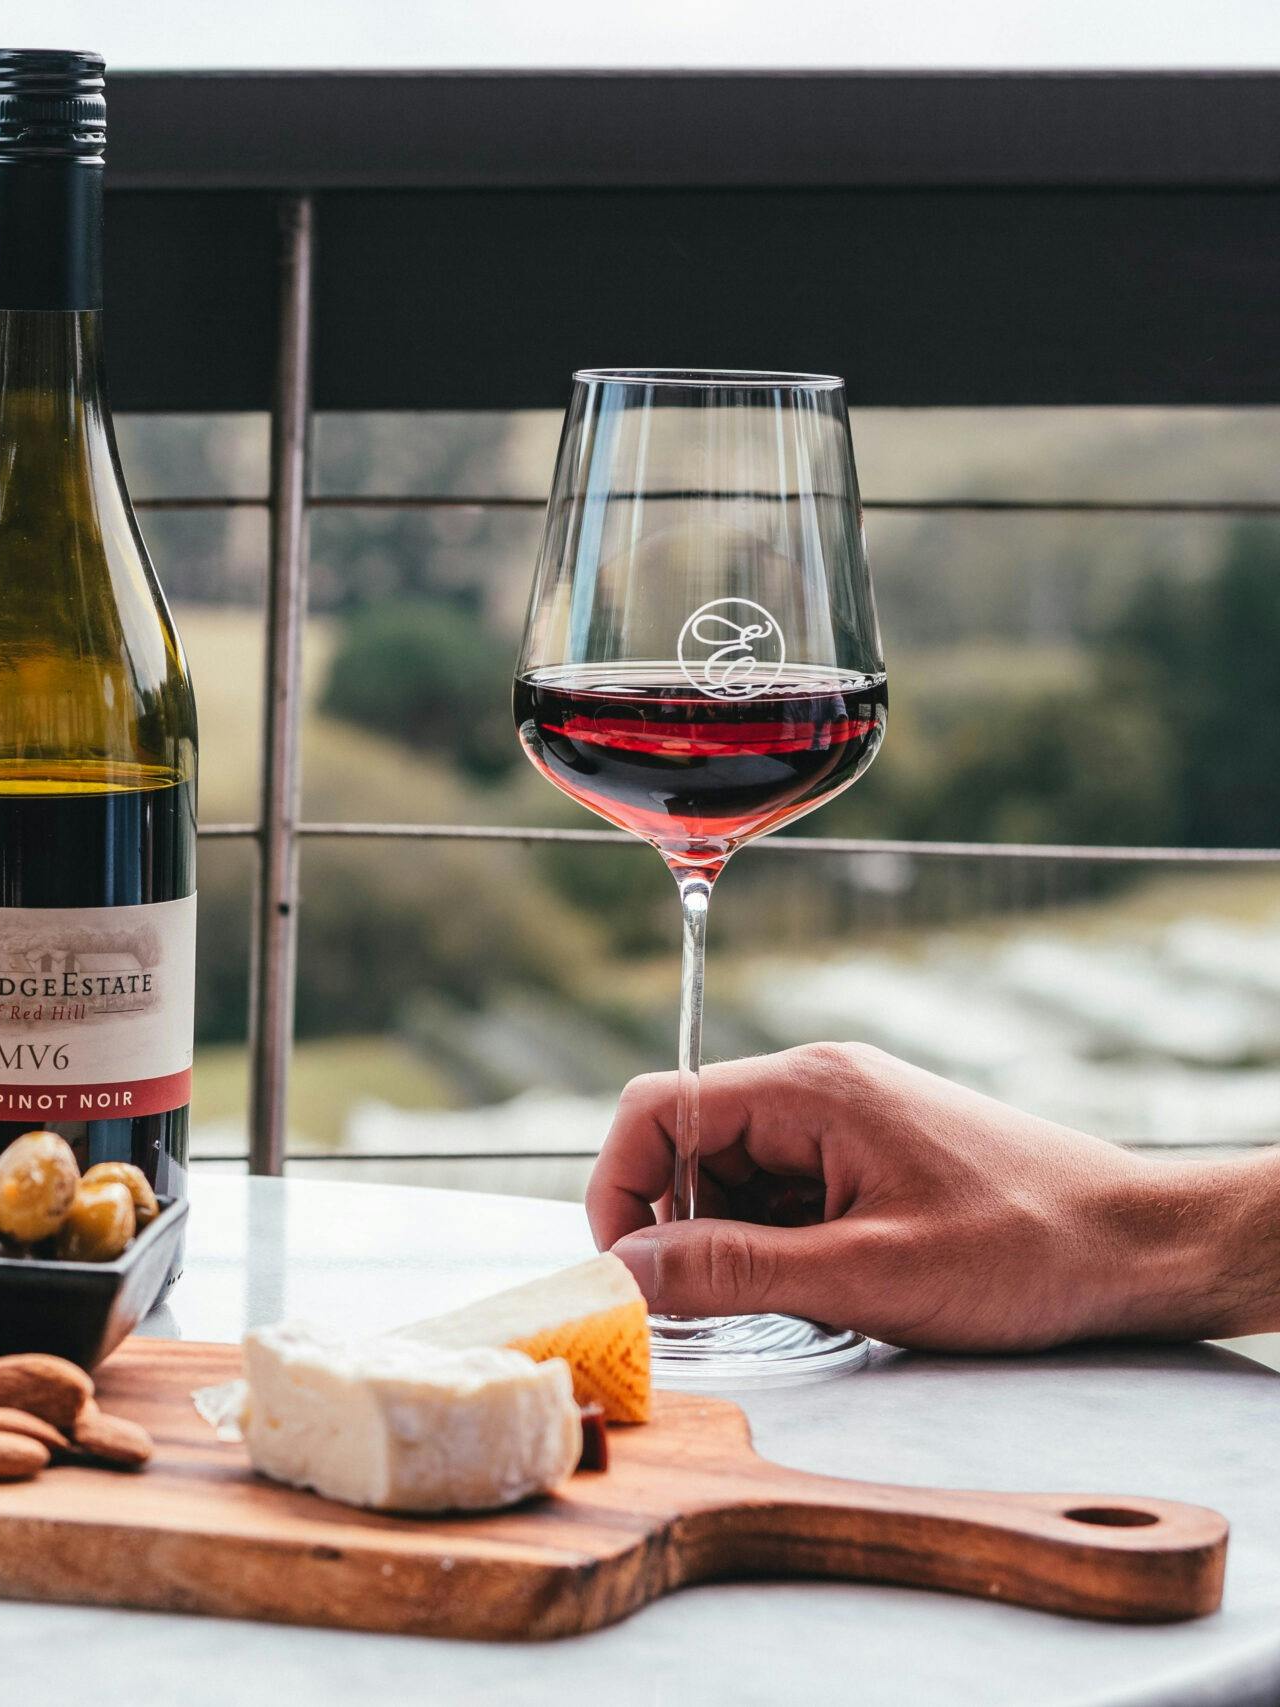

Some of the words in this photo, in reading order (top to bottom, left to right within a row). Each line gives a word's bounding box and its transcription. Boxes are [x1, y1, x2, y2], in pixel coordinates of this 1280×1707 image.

[10, 1004, 43, 1021] Red
[51, 1004, 86, 1021] Hill
[79, 1091, 133, 1109] NOIR
